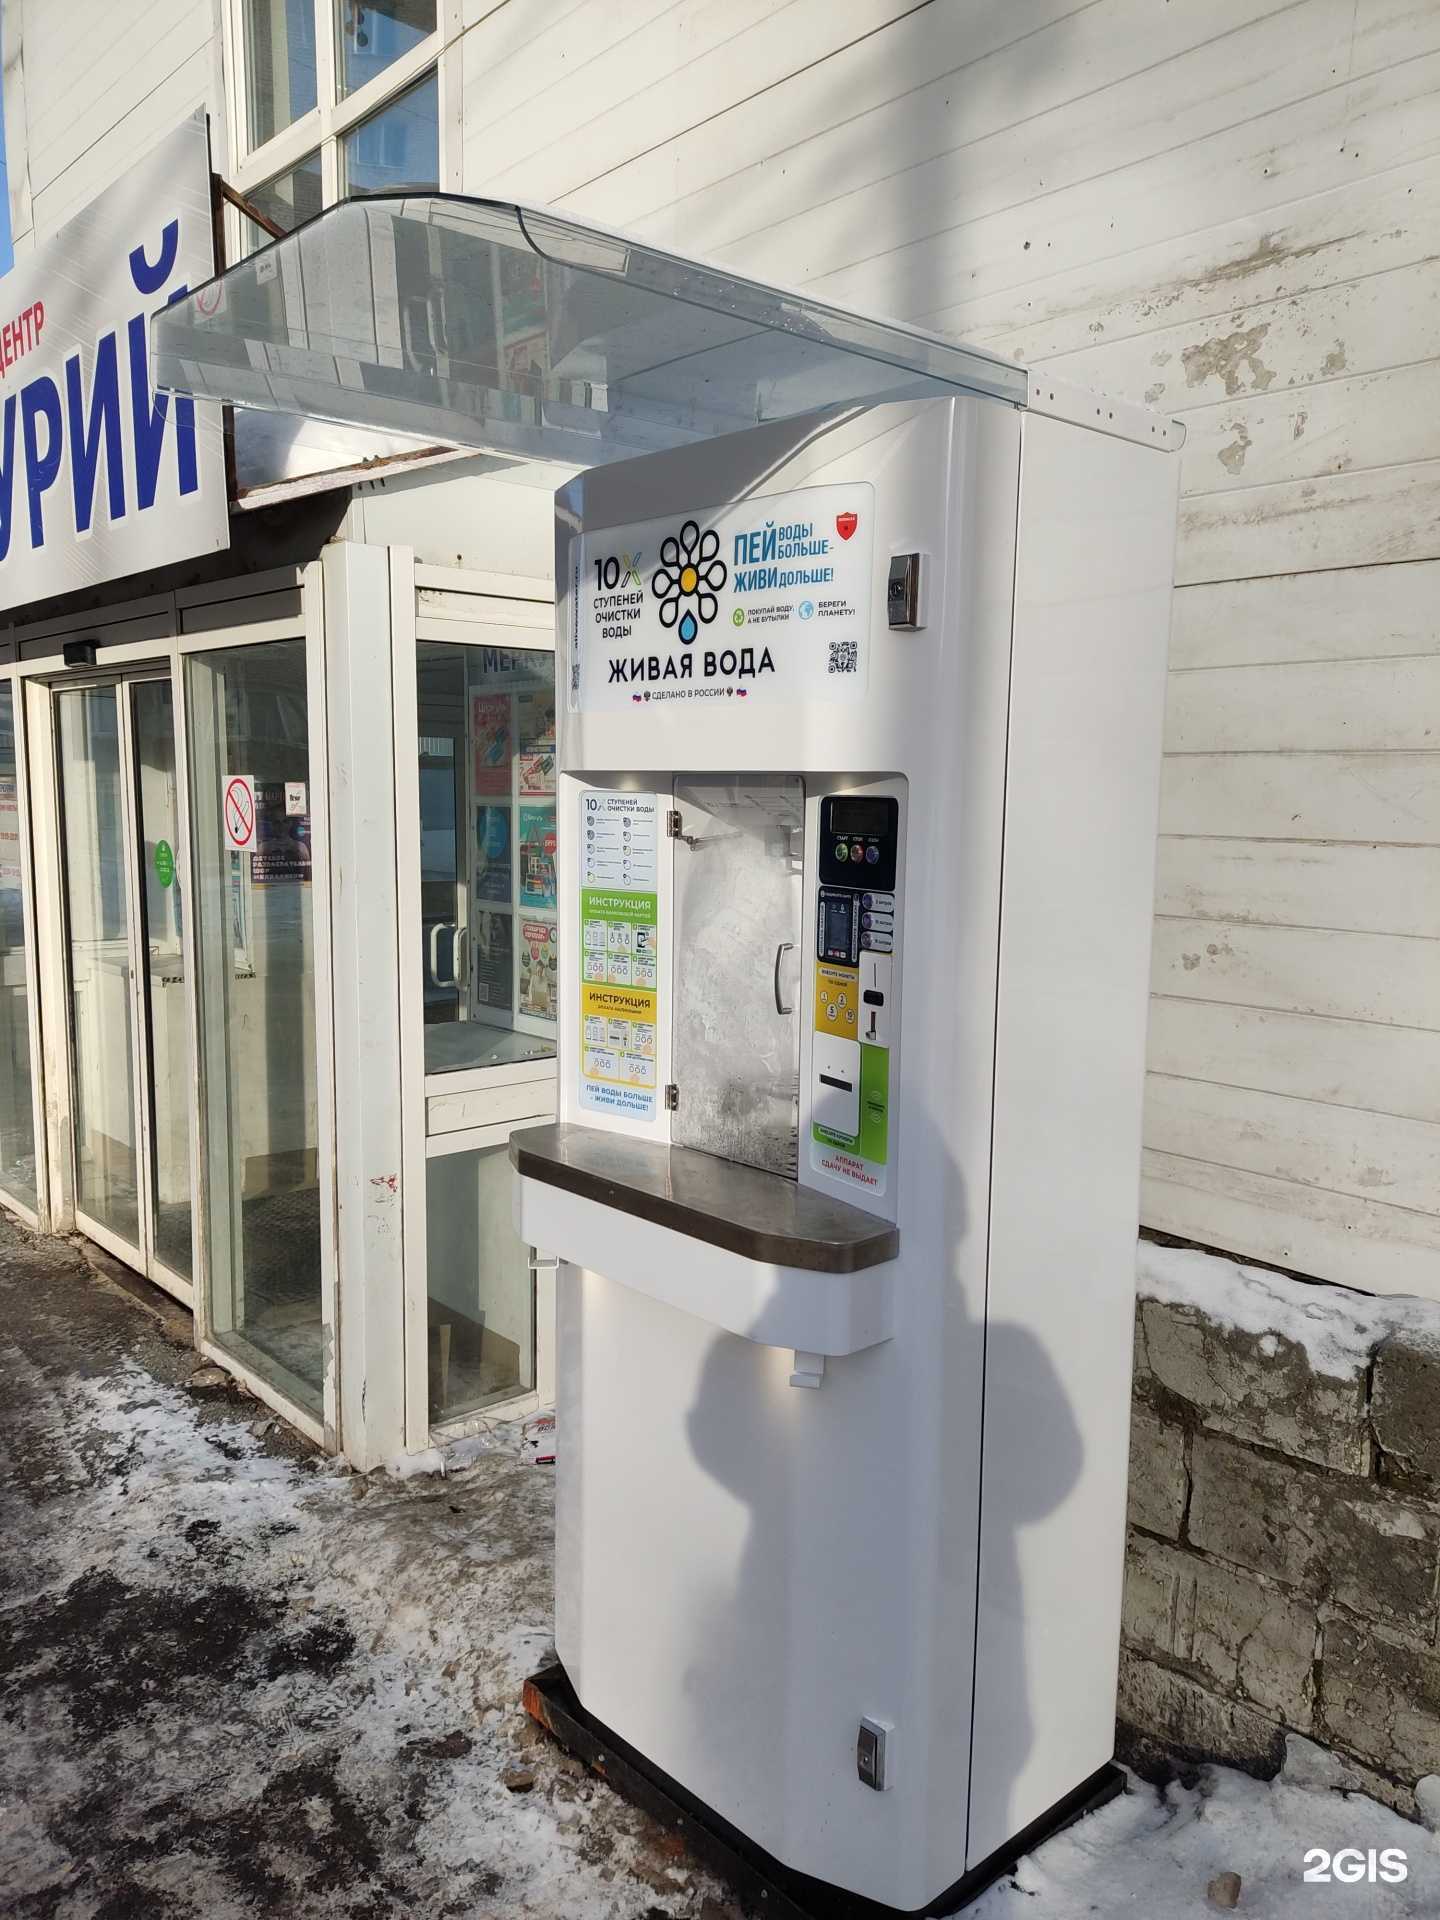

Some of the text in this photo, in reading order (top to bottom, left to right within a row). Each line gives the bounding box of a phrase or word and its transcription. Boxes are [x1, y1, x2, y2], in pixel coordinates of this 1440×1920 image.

[733, 520, 813, 567] ПЕЙ ВОДЫ
[733, 567, 834, 594] ЖИВИ ДОЛЬШЕ!
[593, 589, 644, 610] СТУПЕНЕЙ
[818, 600, 847, 608] БЕРЕГИ
[595, 607, 641, 624] ОЧИСТКИ
[817, 608, 856, 617] ПЛАНЕТУ!
[602, 625, 632, 640] ВОДЫ
[608, 646, 776, 684] ЖИВАЯ ВОДА
[651, 687, 726, 701] СДЕЛАНО В РОССИИ
[607, 798, 638, 806] СТУПЕНЕЙ
[589, 896, 652, 909] ИНСТРУКЦИЯ
[589, 992, 651, 1009] ИНСТРУКЦИЯ
[586, 1084, 653, 1103] ПЕЙ ВОДЫ БОЛЬШЕ
[594, 1095, 649, 1112] ЖИВИ ДОЛЬШЕ!
[835, 1155, 864, 1170] АППАРАТ
[821, 1159, 841, 1171] СДАЧУ
[851, 1170, 878, 1185] ВЫДАЕТ
